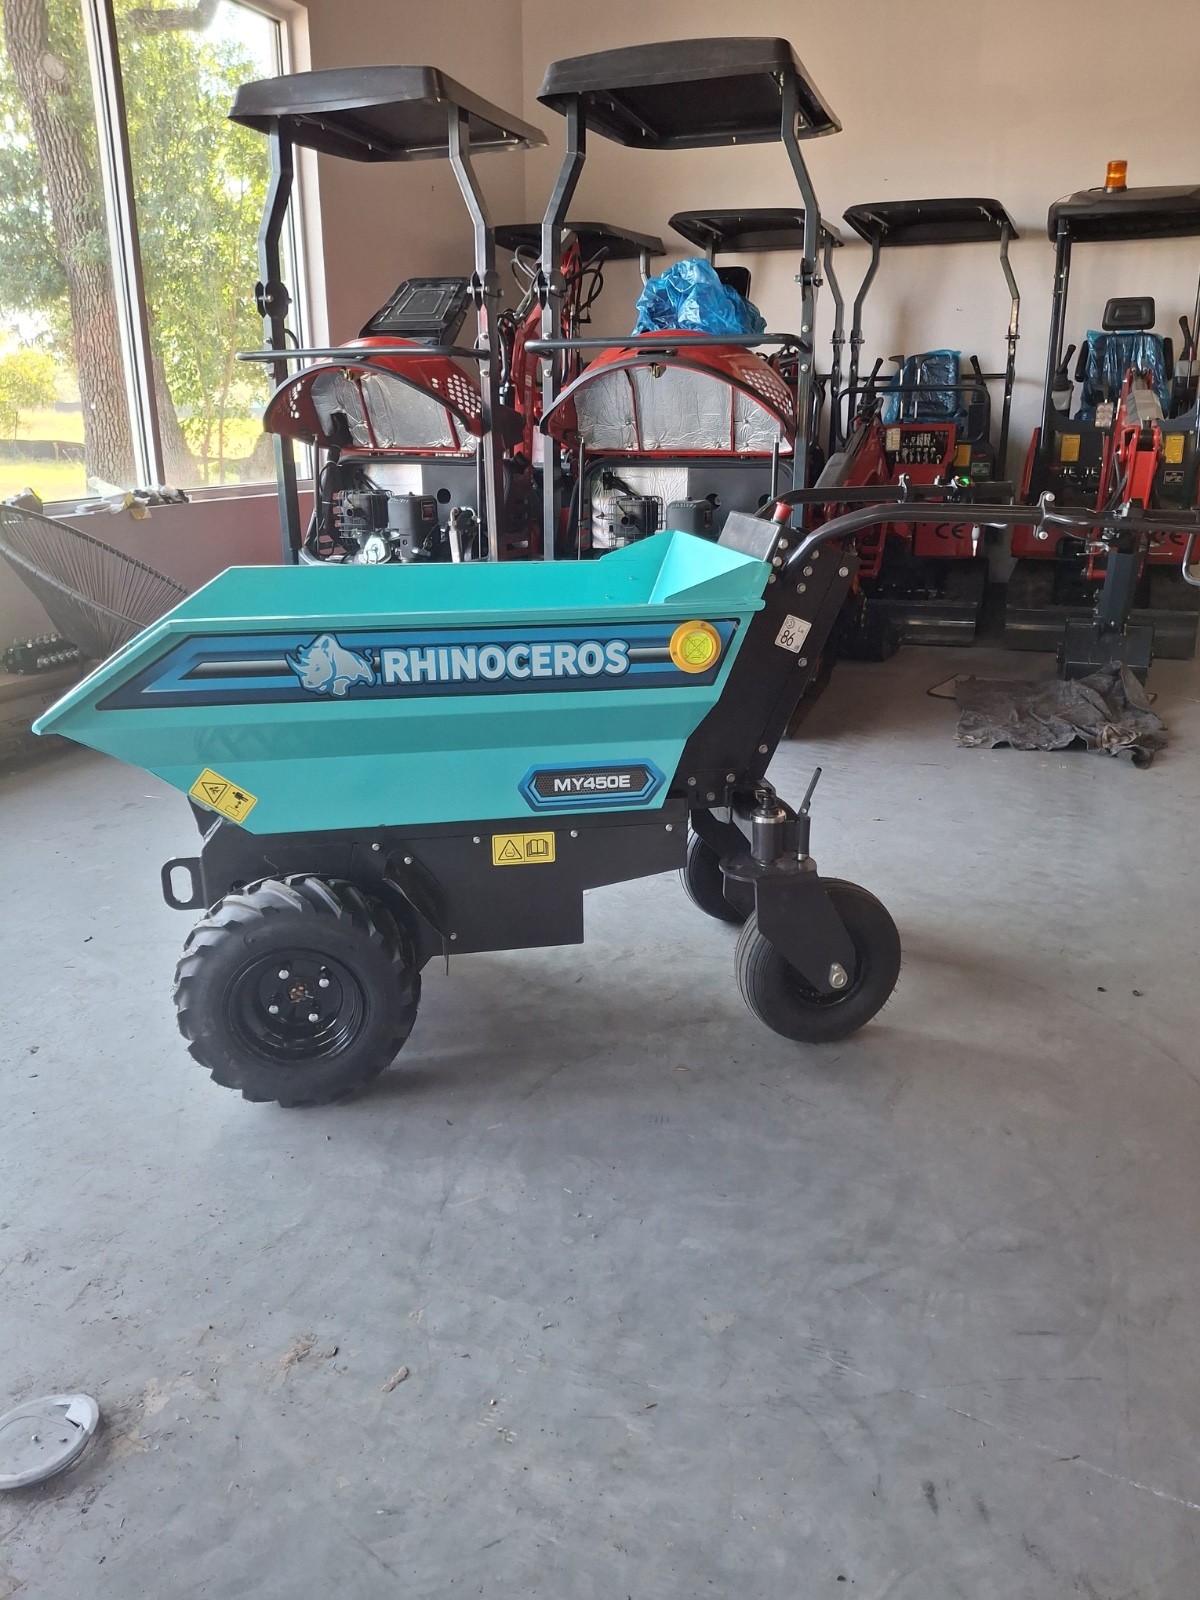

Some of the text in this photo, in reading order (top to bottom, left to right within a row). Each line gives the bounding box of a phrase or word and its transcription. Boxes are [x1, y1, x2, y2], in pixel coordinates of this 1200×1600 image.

[934, 522, 966, 540] CE
[780, 629, 796, 647] 86
[382, 641, 629, 684] RHINOCEROS
[553, 774, 631, 792] MY450E
